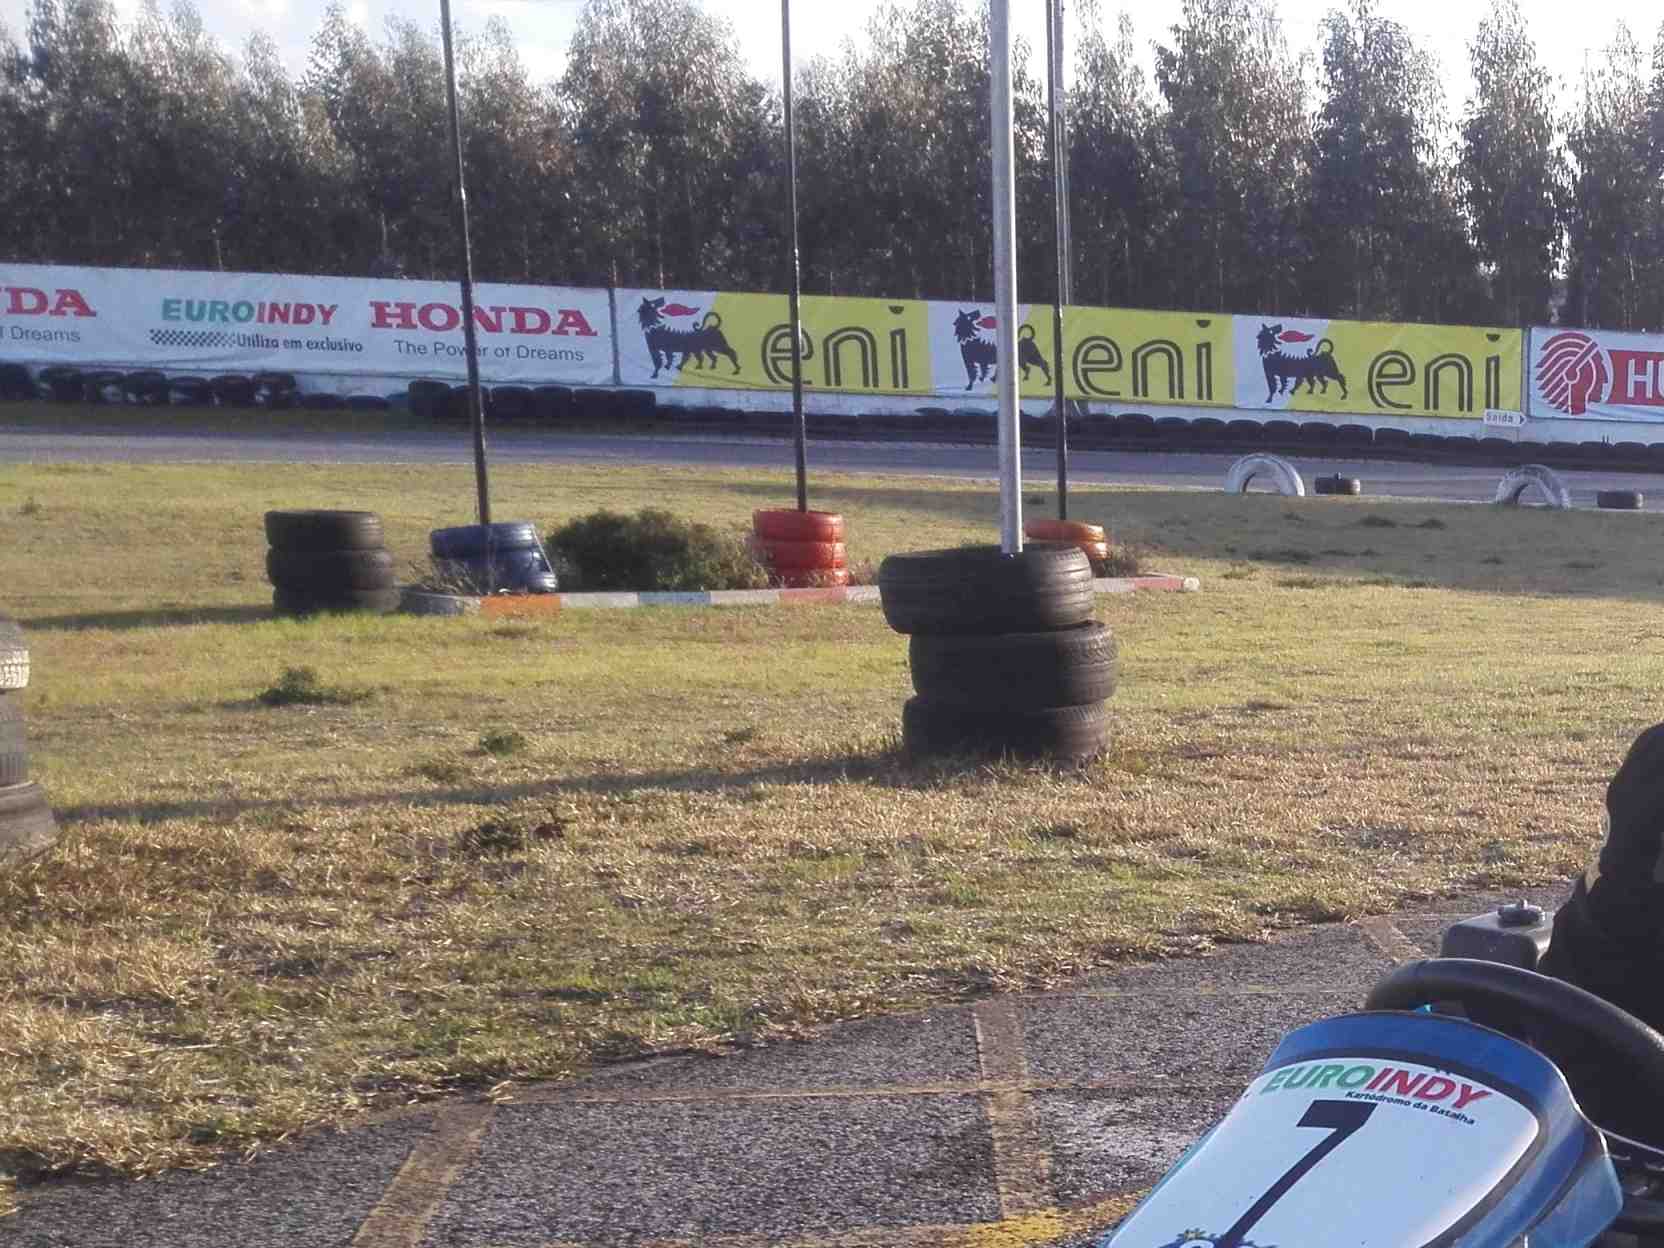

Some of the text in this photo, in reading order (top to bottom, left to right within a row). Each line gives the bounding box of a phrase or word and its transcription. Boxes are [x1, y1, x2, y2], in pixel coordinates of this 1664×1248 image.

[0, 286, 97, 318] DA
[161, 297, 339, 326] EUROINDY
[369, 300, 599, 337] HONDA
[11, 325, 81, 343] Dreams
[283, 339, 302, 349] em
[306, 337, 363, 352] exclusivo
[393, 339, 427, 355] The
[493, 346, 511, 359] of
[516, 344, 584, 362] Dreams
[760, 304, 909, 389] eni
[1072, 319, 1213, 400] eni
[1367, 333, 1501, 412] eni
[1259, 1064, 1492, 1110] EUROINDY
[1344, 1090, 1476, 1126] Kartódromo da Batalha
[1225, 1099, 1379, 1248] 7
